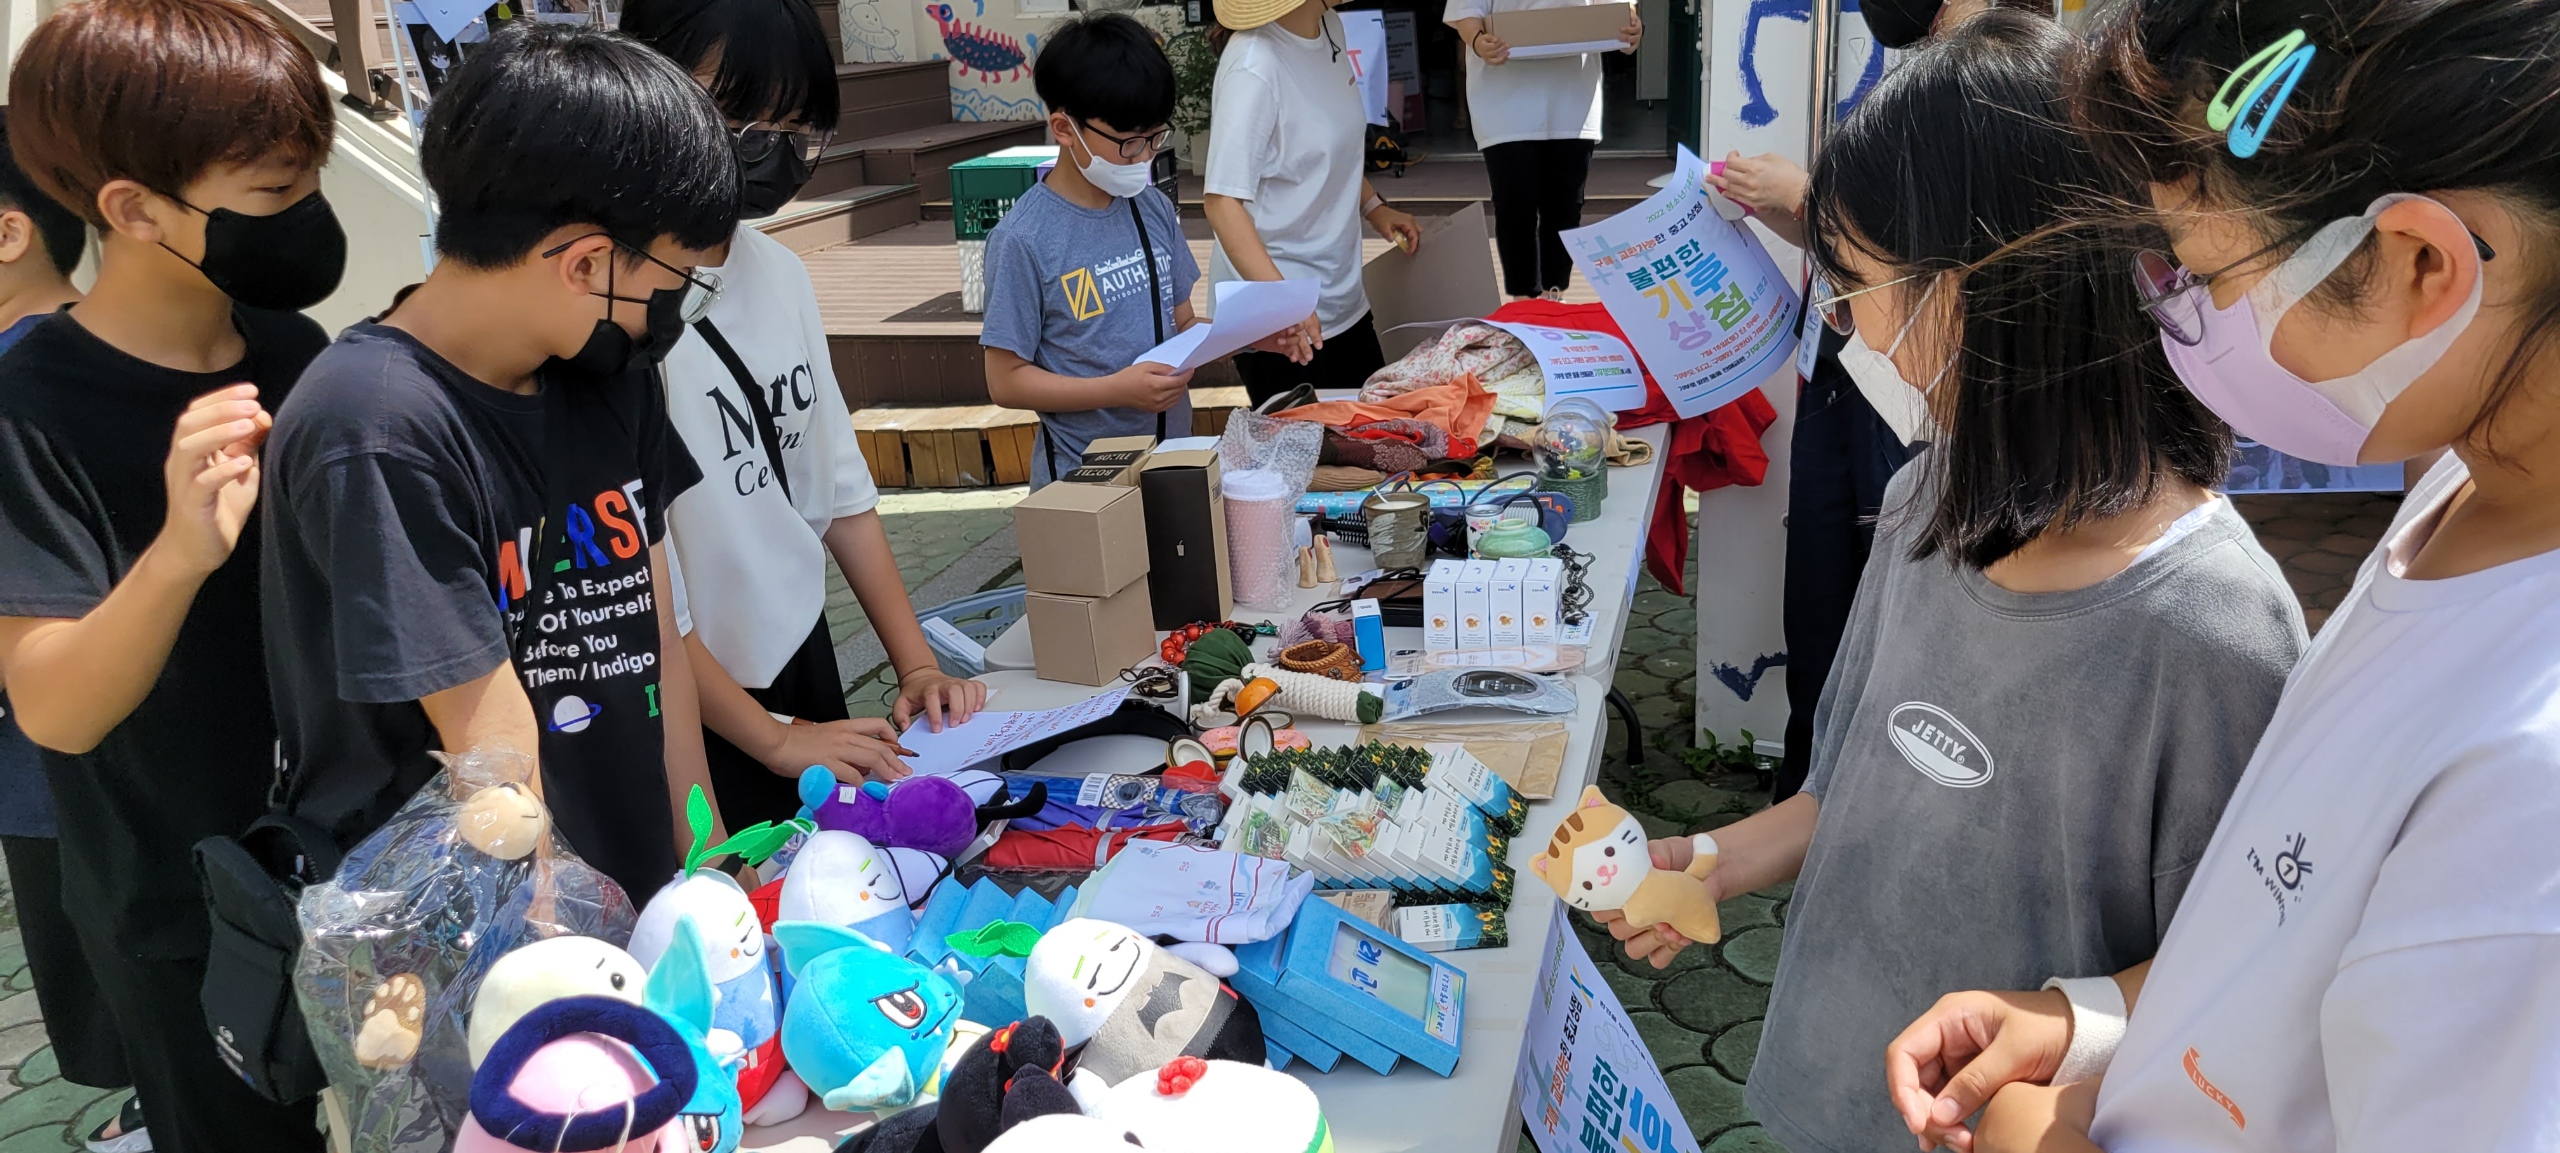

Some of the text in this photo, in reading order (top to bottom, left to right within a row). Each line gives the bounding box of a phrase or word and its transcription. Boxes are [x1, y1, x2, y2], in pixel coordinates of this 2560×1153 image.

[1646, 208, 1665, 223] 2022
[1625, 238, 1704, 291] 불편한
[1642, 251, 1729, 320] 기후
[1668, 281, 1752, 351] 상점
[558, 565, 650, 600] To Expect
[539, 612, 568, 633] Of
[571, 592, 652, 627] Yourself
[583, 633, 618, 655] You
[524, 664, 577, 688] Them
[593, 652, 655, 680] Indigo
[2192, 1070, 2233, 1110] LUCKY
